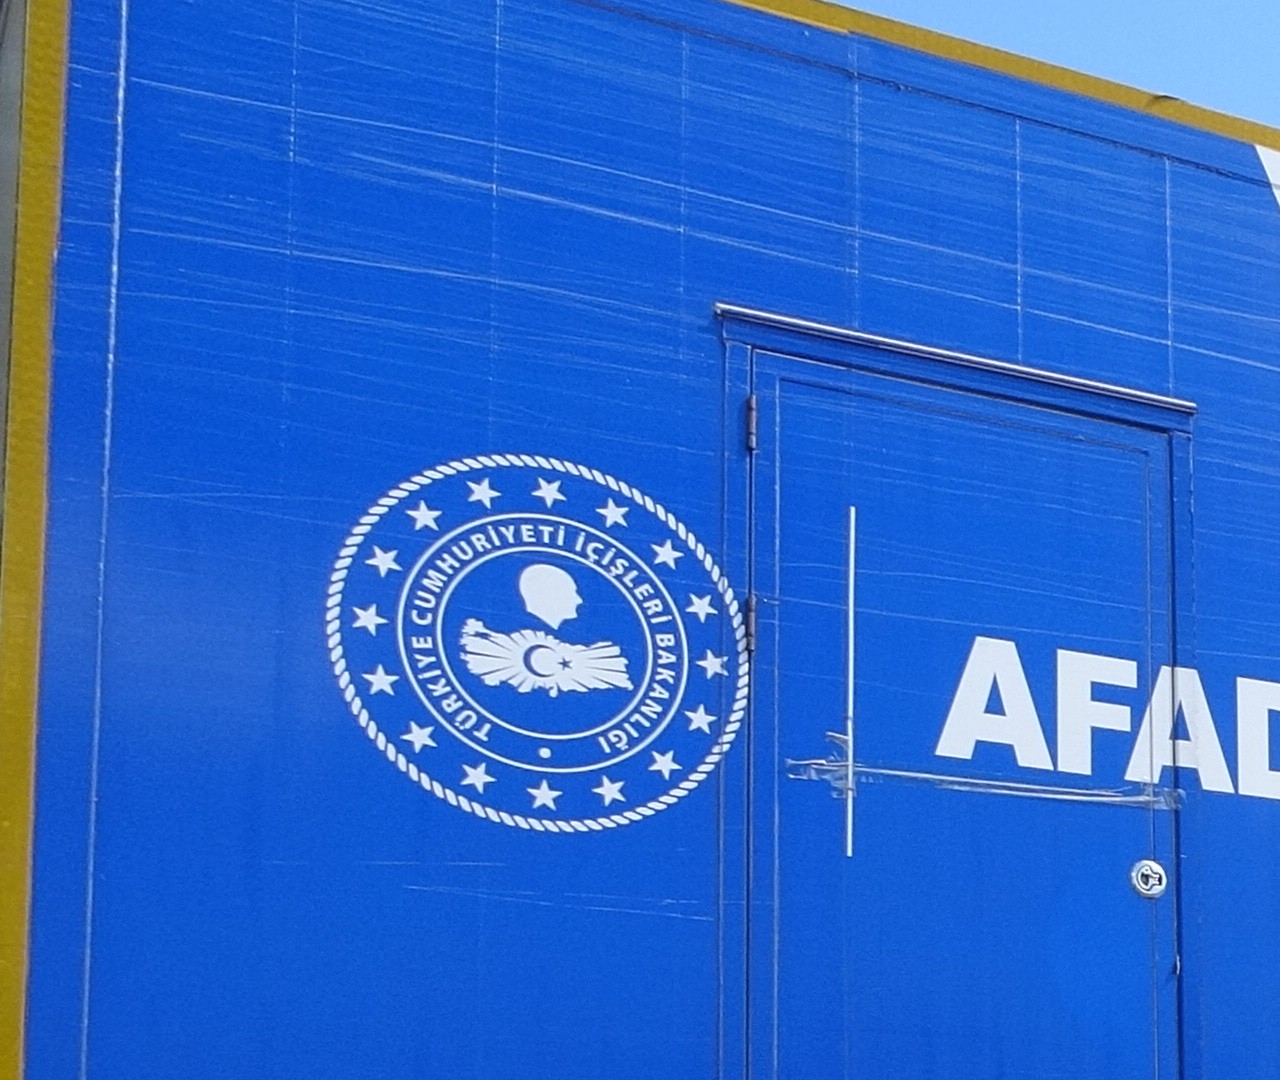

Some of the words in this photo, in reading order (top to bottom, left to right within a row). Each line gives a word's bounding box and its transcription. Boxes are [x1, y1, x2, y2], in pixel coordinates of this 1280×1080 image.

[411, 523, 565, 627] CUMHURİYETİ
[574, 530, 673, 626] İÇİŞLERİ
[413, 636, 493, 743] TÜRKİYE
[600, 633, 677, 755] BAKANLIĞI
